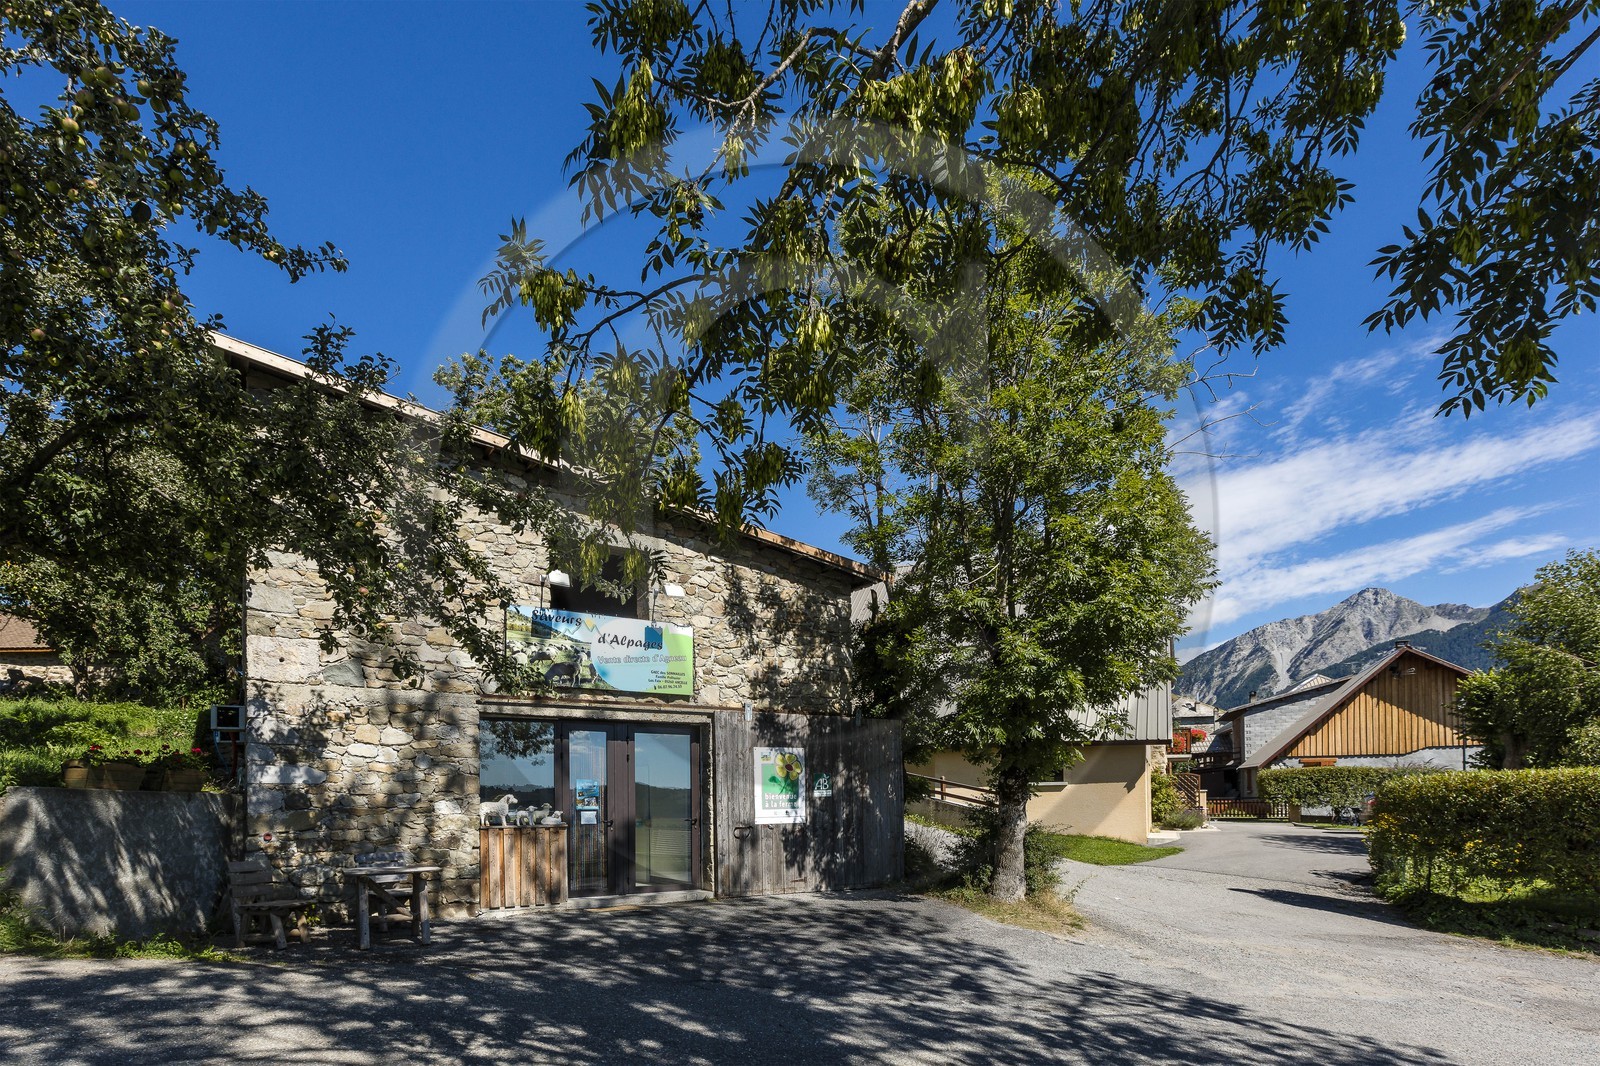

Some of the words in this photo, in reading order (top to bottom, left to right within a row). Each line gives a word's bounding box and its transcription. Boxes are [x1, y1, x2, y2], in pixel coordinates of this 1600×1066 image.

[531, 609, 582, 626] Saveurs
[597, 633, 663, 651] d'Alpages
[597, 655, 621, 664] Vente
[623, 655, 650, 663] directe
[652, 654, 687, 663] d'Agneau
[814, 778, 829, 790] AB
